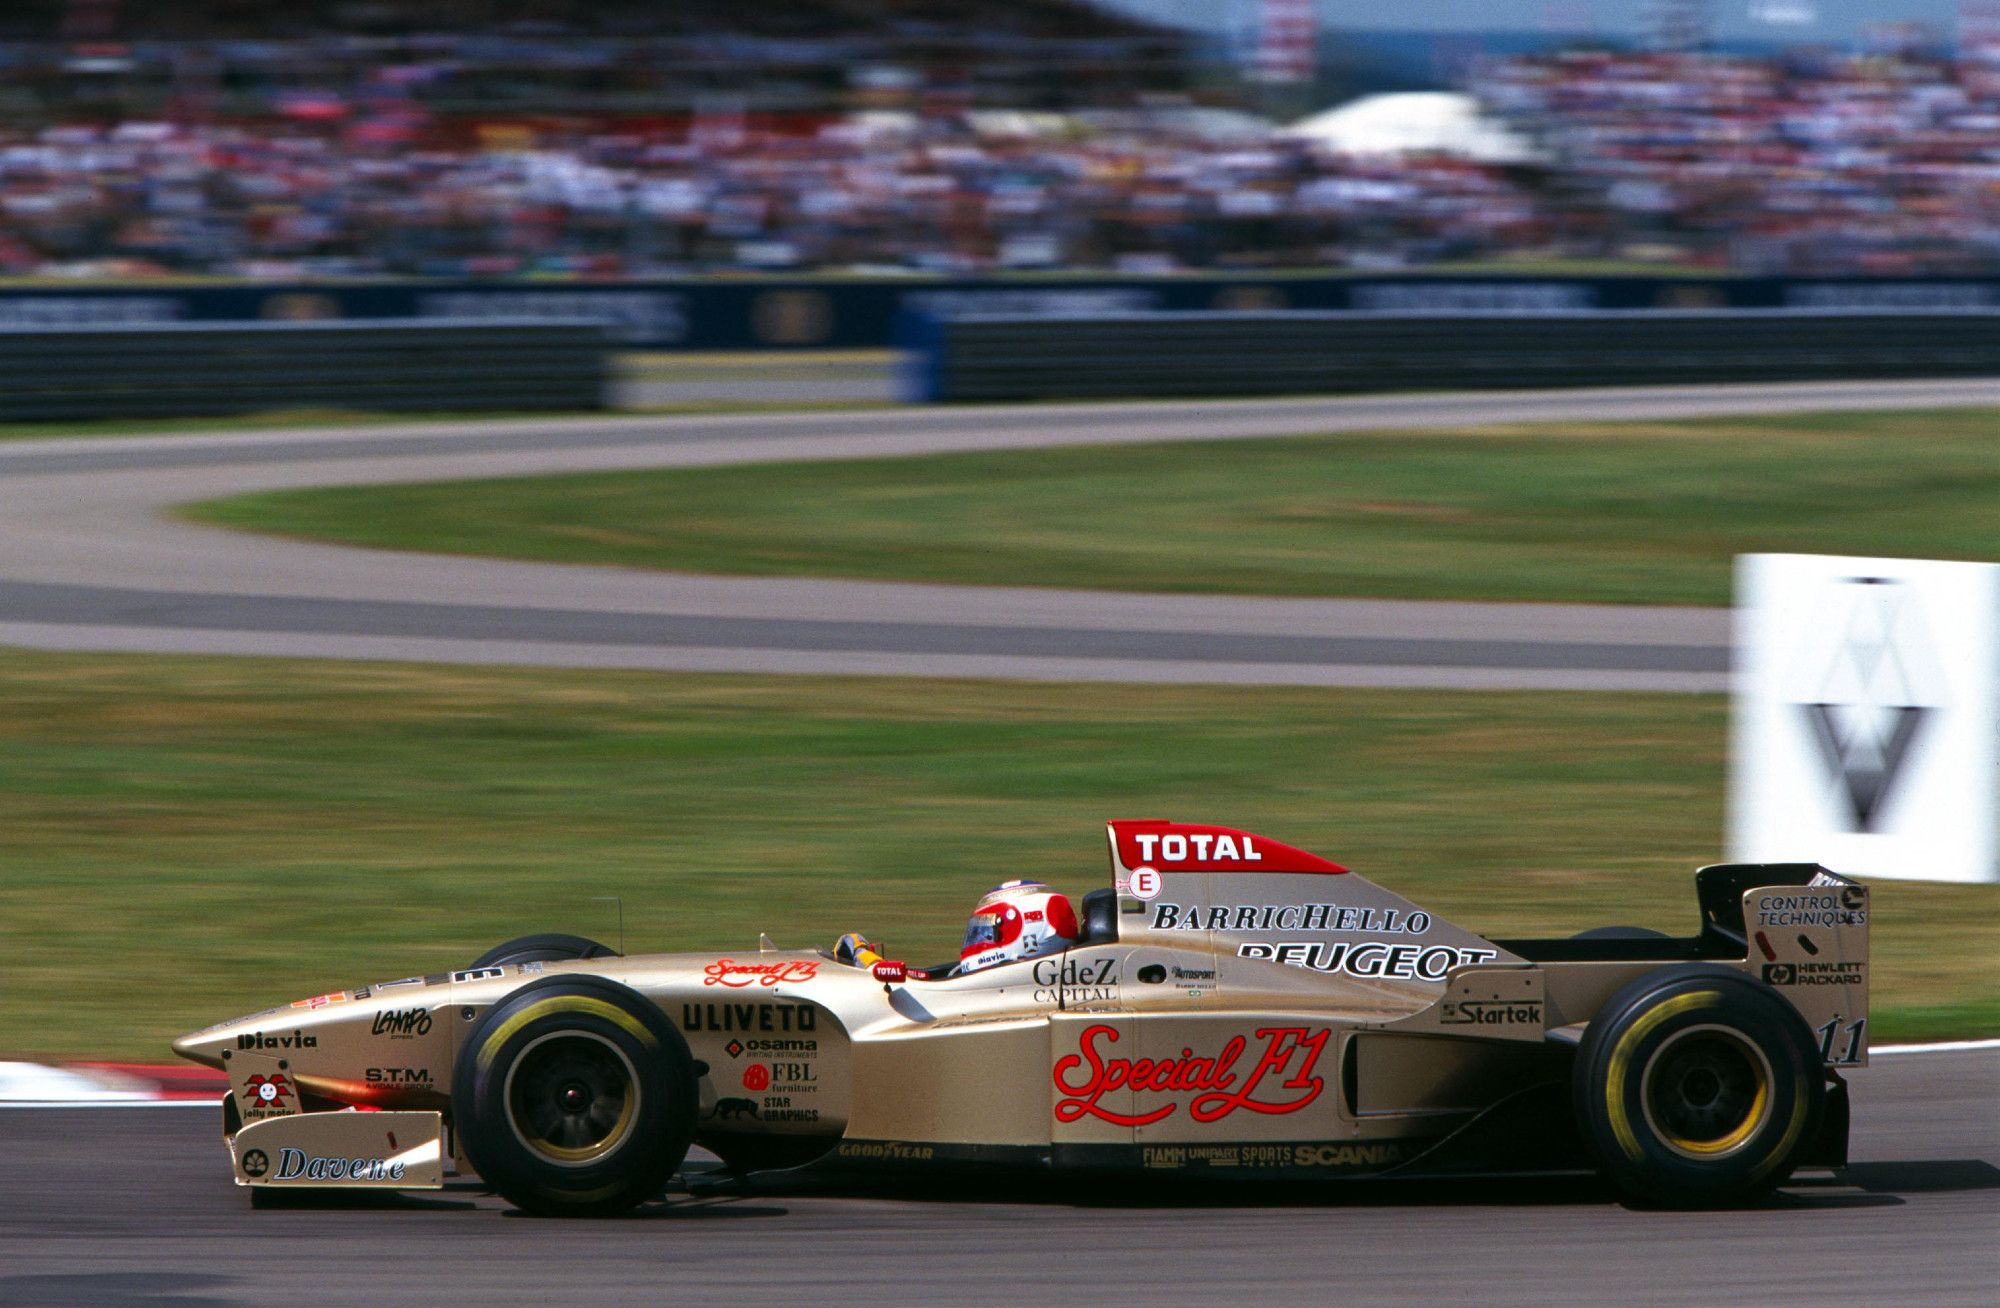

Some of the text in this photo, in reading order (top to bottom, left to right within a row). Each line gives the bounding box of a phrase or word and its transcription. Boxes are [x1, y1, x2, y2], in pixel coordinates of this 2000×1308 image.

[1135, 834, 1262, 861] TOTAL
[1139, 874, 1152, 892] E
[1760, 896, 1840, 911] CONTROL
[1149, 902, 1430, 935] BARRICHELLO
[1758, 911, 1866, 928] TECHNIQUES
[704, 958, 786, 987] Special
[877, 966, 902, 976] TOTAL
[1033, 957, 1116, 986] GdeZ
[1798, 963, 1861, 973] HEWLETT
[1798, 974, 1862, 985] PACKARD
[1033, 988, 1116, 1003] CAPITAL
[683, 1003, 817, 1031] ULIVETO
[1441, 1000, 1542, 1024] Startek
[372, 1008, 432, 1035] LAMPO
[237, 1031, 317, 1050] Diavia
[746, 1039, 817, 1051] osama
[1818, 1018, 1866, 1064] 11
[365, 1068, 434, 1082] S.T.M.
[772, 1063, 817, 1081] FBL
[1053, 1024, 1246, 1127] Special
[772, 1084, 817, 1093] furniture
[764, 1097, 791, 1107] STAR
[764, 1110, 818, 1121] GRAPHICS
[1143, 1147, 1186, 1162] FIAMM
[1188, 1147, 1239, 1160] UNIPART
[274, 1147, 406, 1181] Davene
